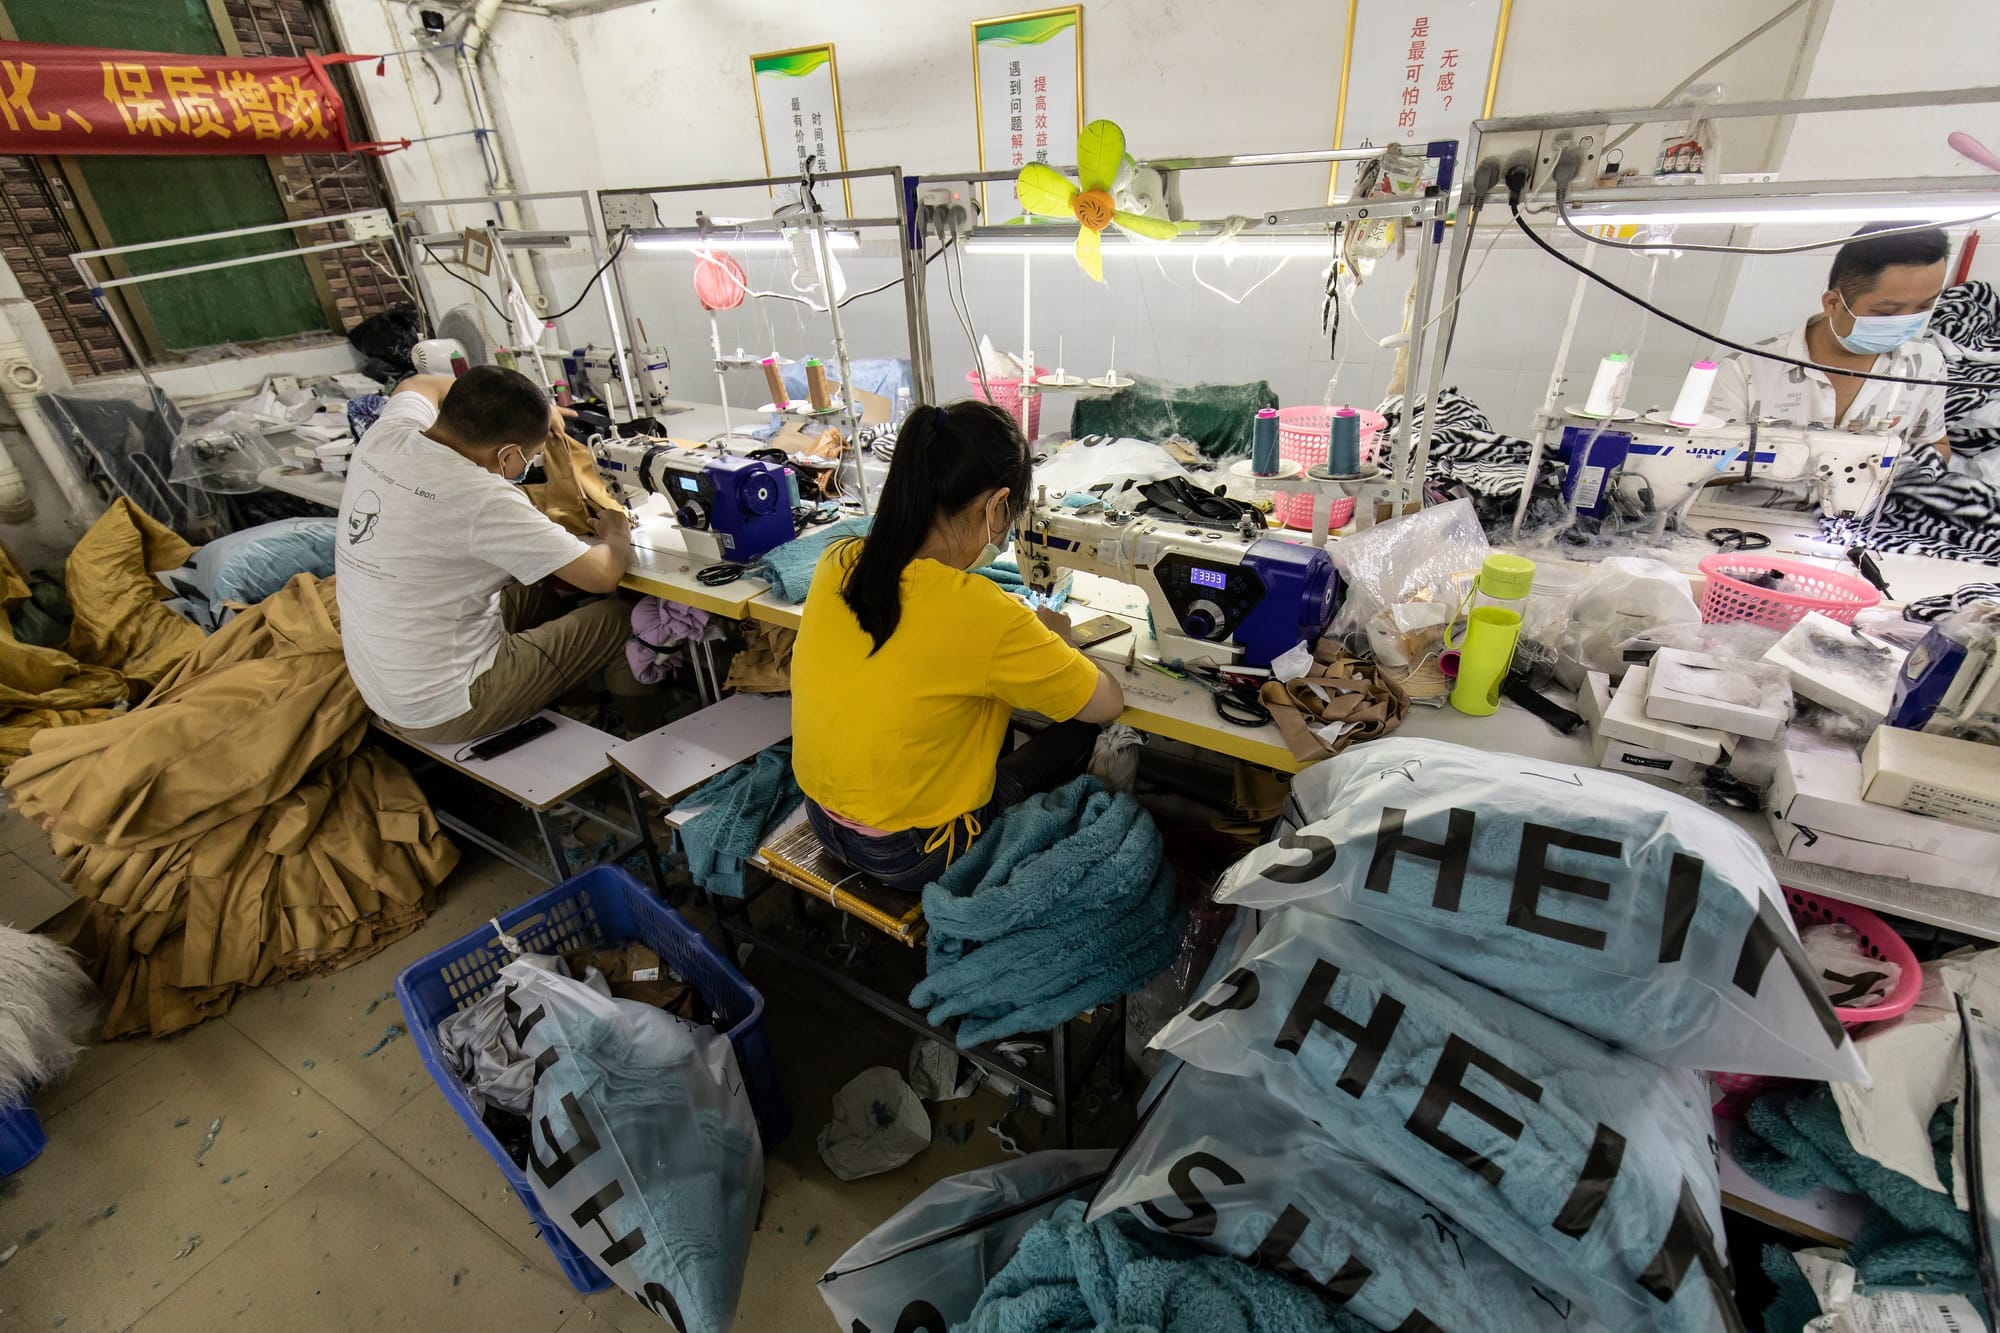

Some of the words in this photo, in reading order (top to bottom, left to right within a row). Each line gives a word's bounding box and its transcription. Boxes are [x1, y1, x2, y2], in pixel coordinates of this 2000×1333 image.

[0, 60, 337, 140] 化、保质增效
[1398, 16, 1430, 138] 是最可怕的。
[414, 486, 436, 501] Leon
